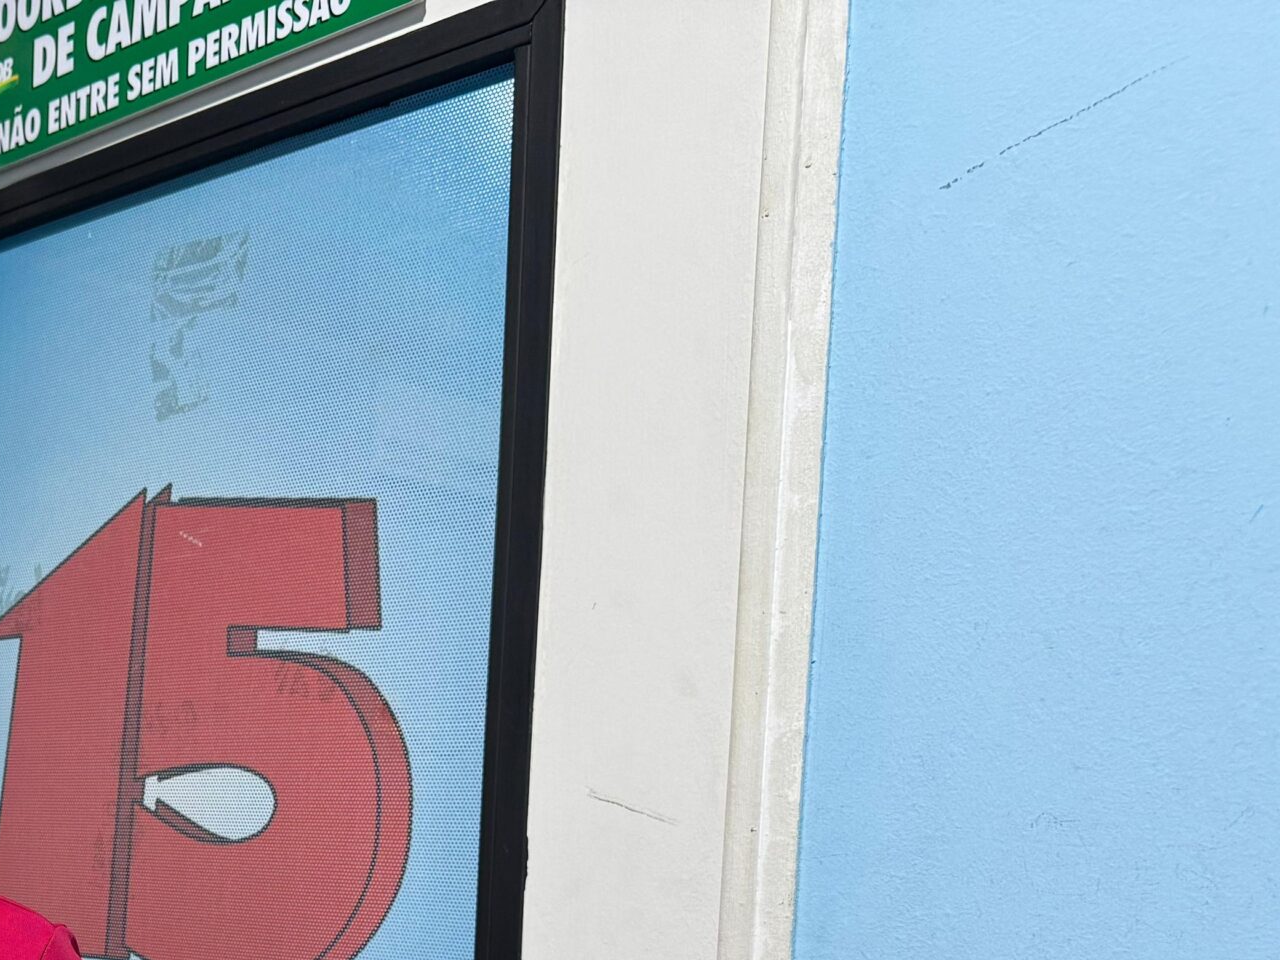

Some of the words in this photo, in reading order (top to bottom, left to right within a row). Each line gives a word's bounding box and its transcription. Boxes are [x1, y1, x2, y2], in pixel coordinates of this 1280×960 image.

[32, 21, 75, 89] DE
[86, 0, 231, 61] CAMP
[47, 72, 120, 135] ENTRE
[126, 47, 179, 102] SEM
